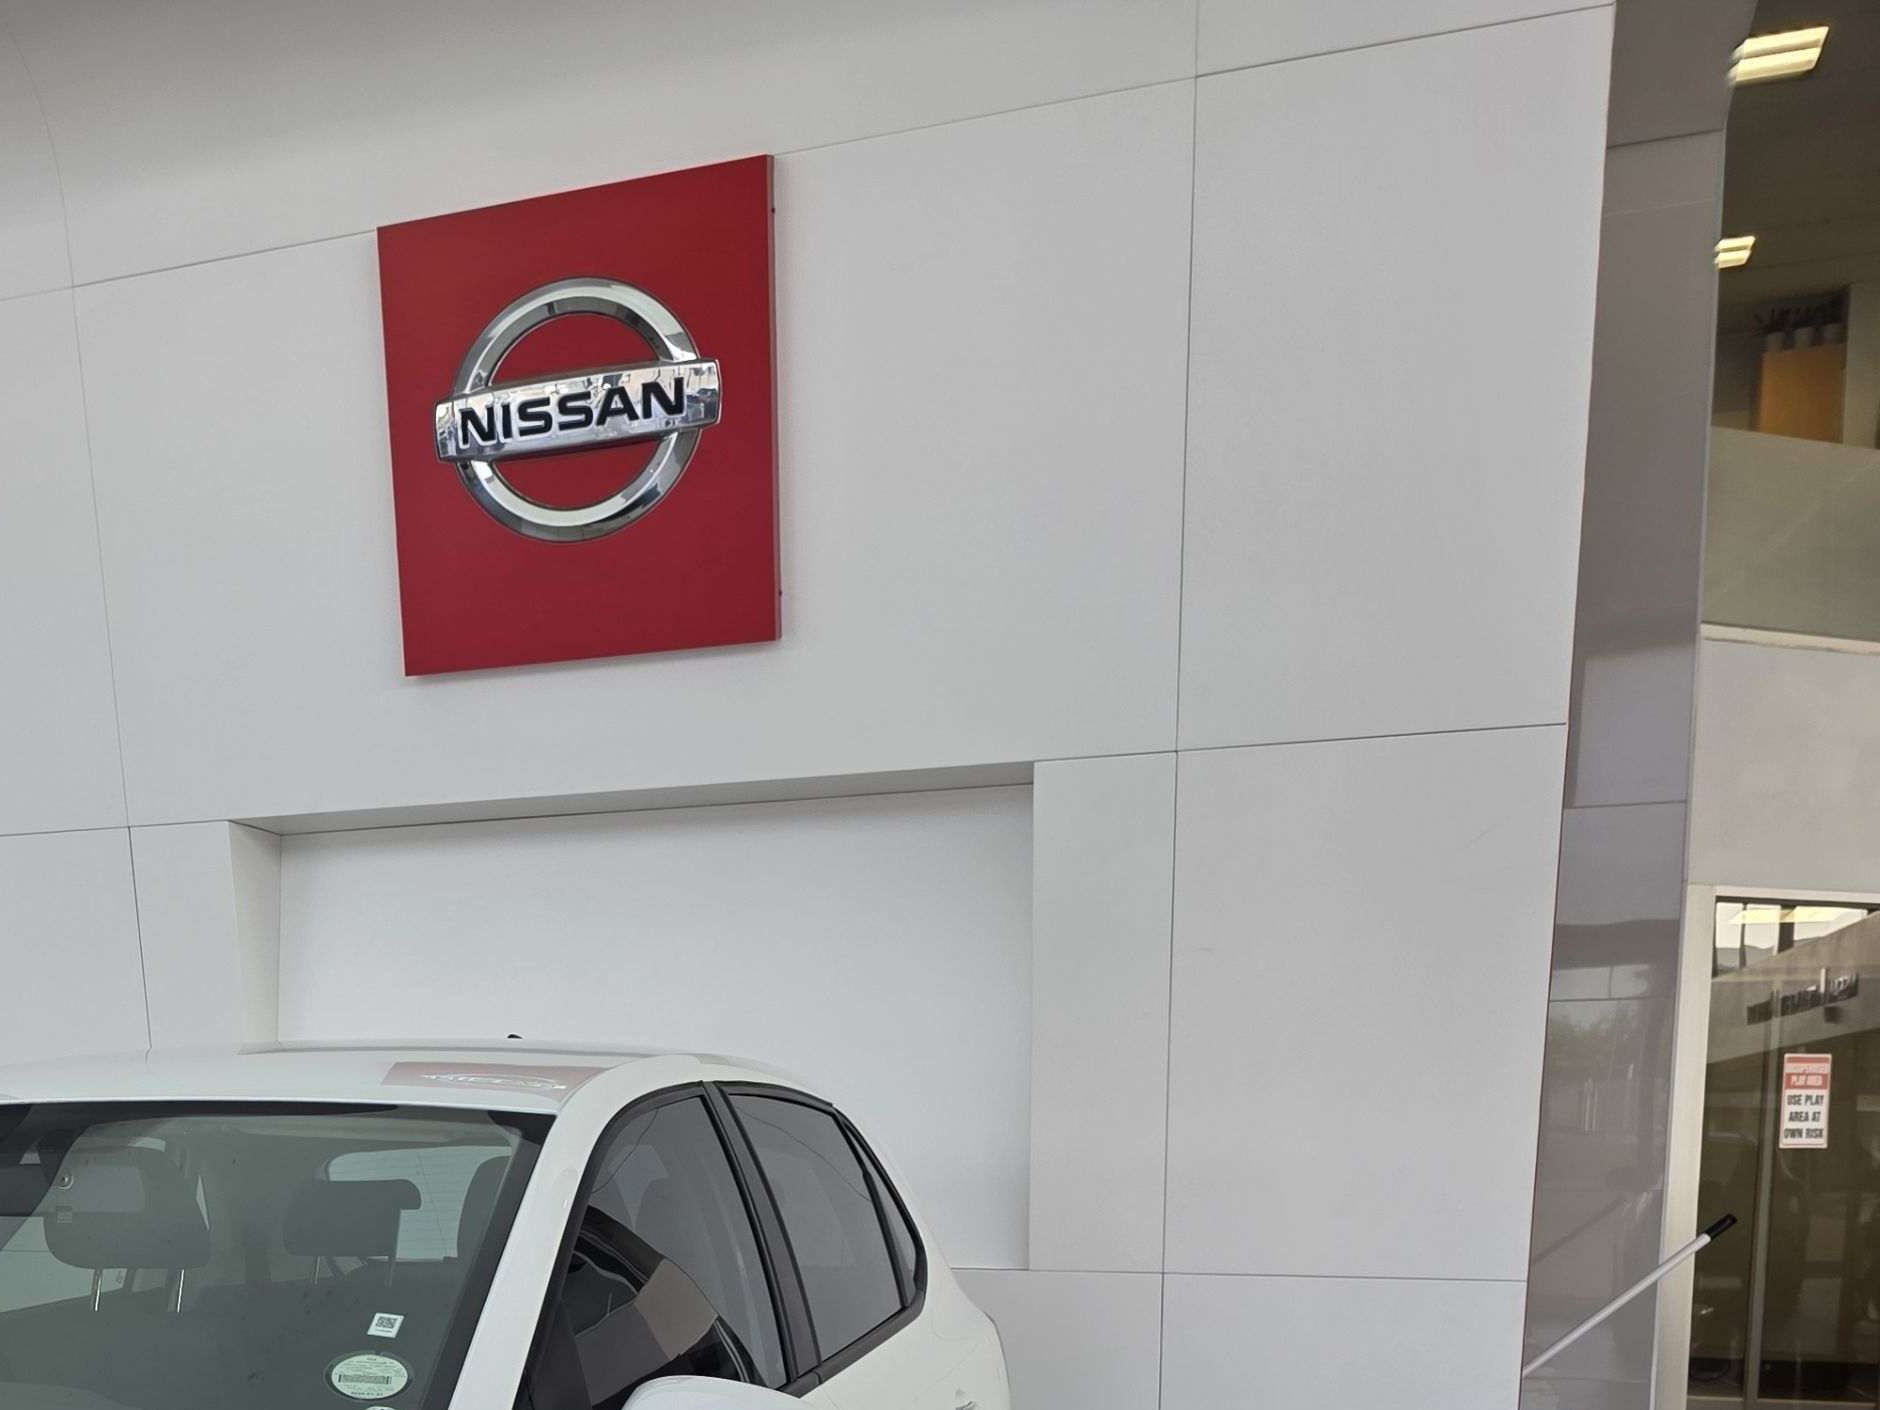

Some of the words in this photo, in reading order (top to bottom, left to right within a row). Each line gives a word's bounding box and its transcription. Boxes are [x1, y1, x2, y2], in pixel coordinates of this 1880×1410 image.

[458, 376, 686, 448] NISSAN
[1787, 1095, 1802, 1106] USE
[1805, 1095, 1824, 1106] PLAY
[1788, 1111, 1809, 1122] AREA
[1811, 1111, 1821, 1122] AT
[1784, 1128, 1803, 1139] OWN
[1805, 1128, 1824, 1139] RISK
